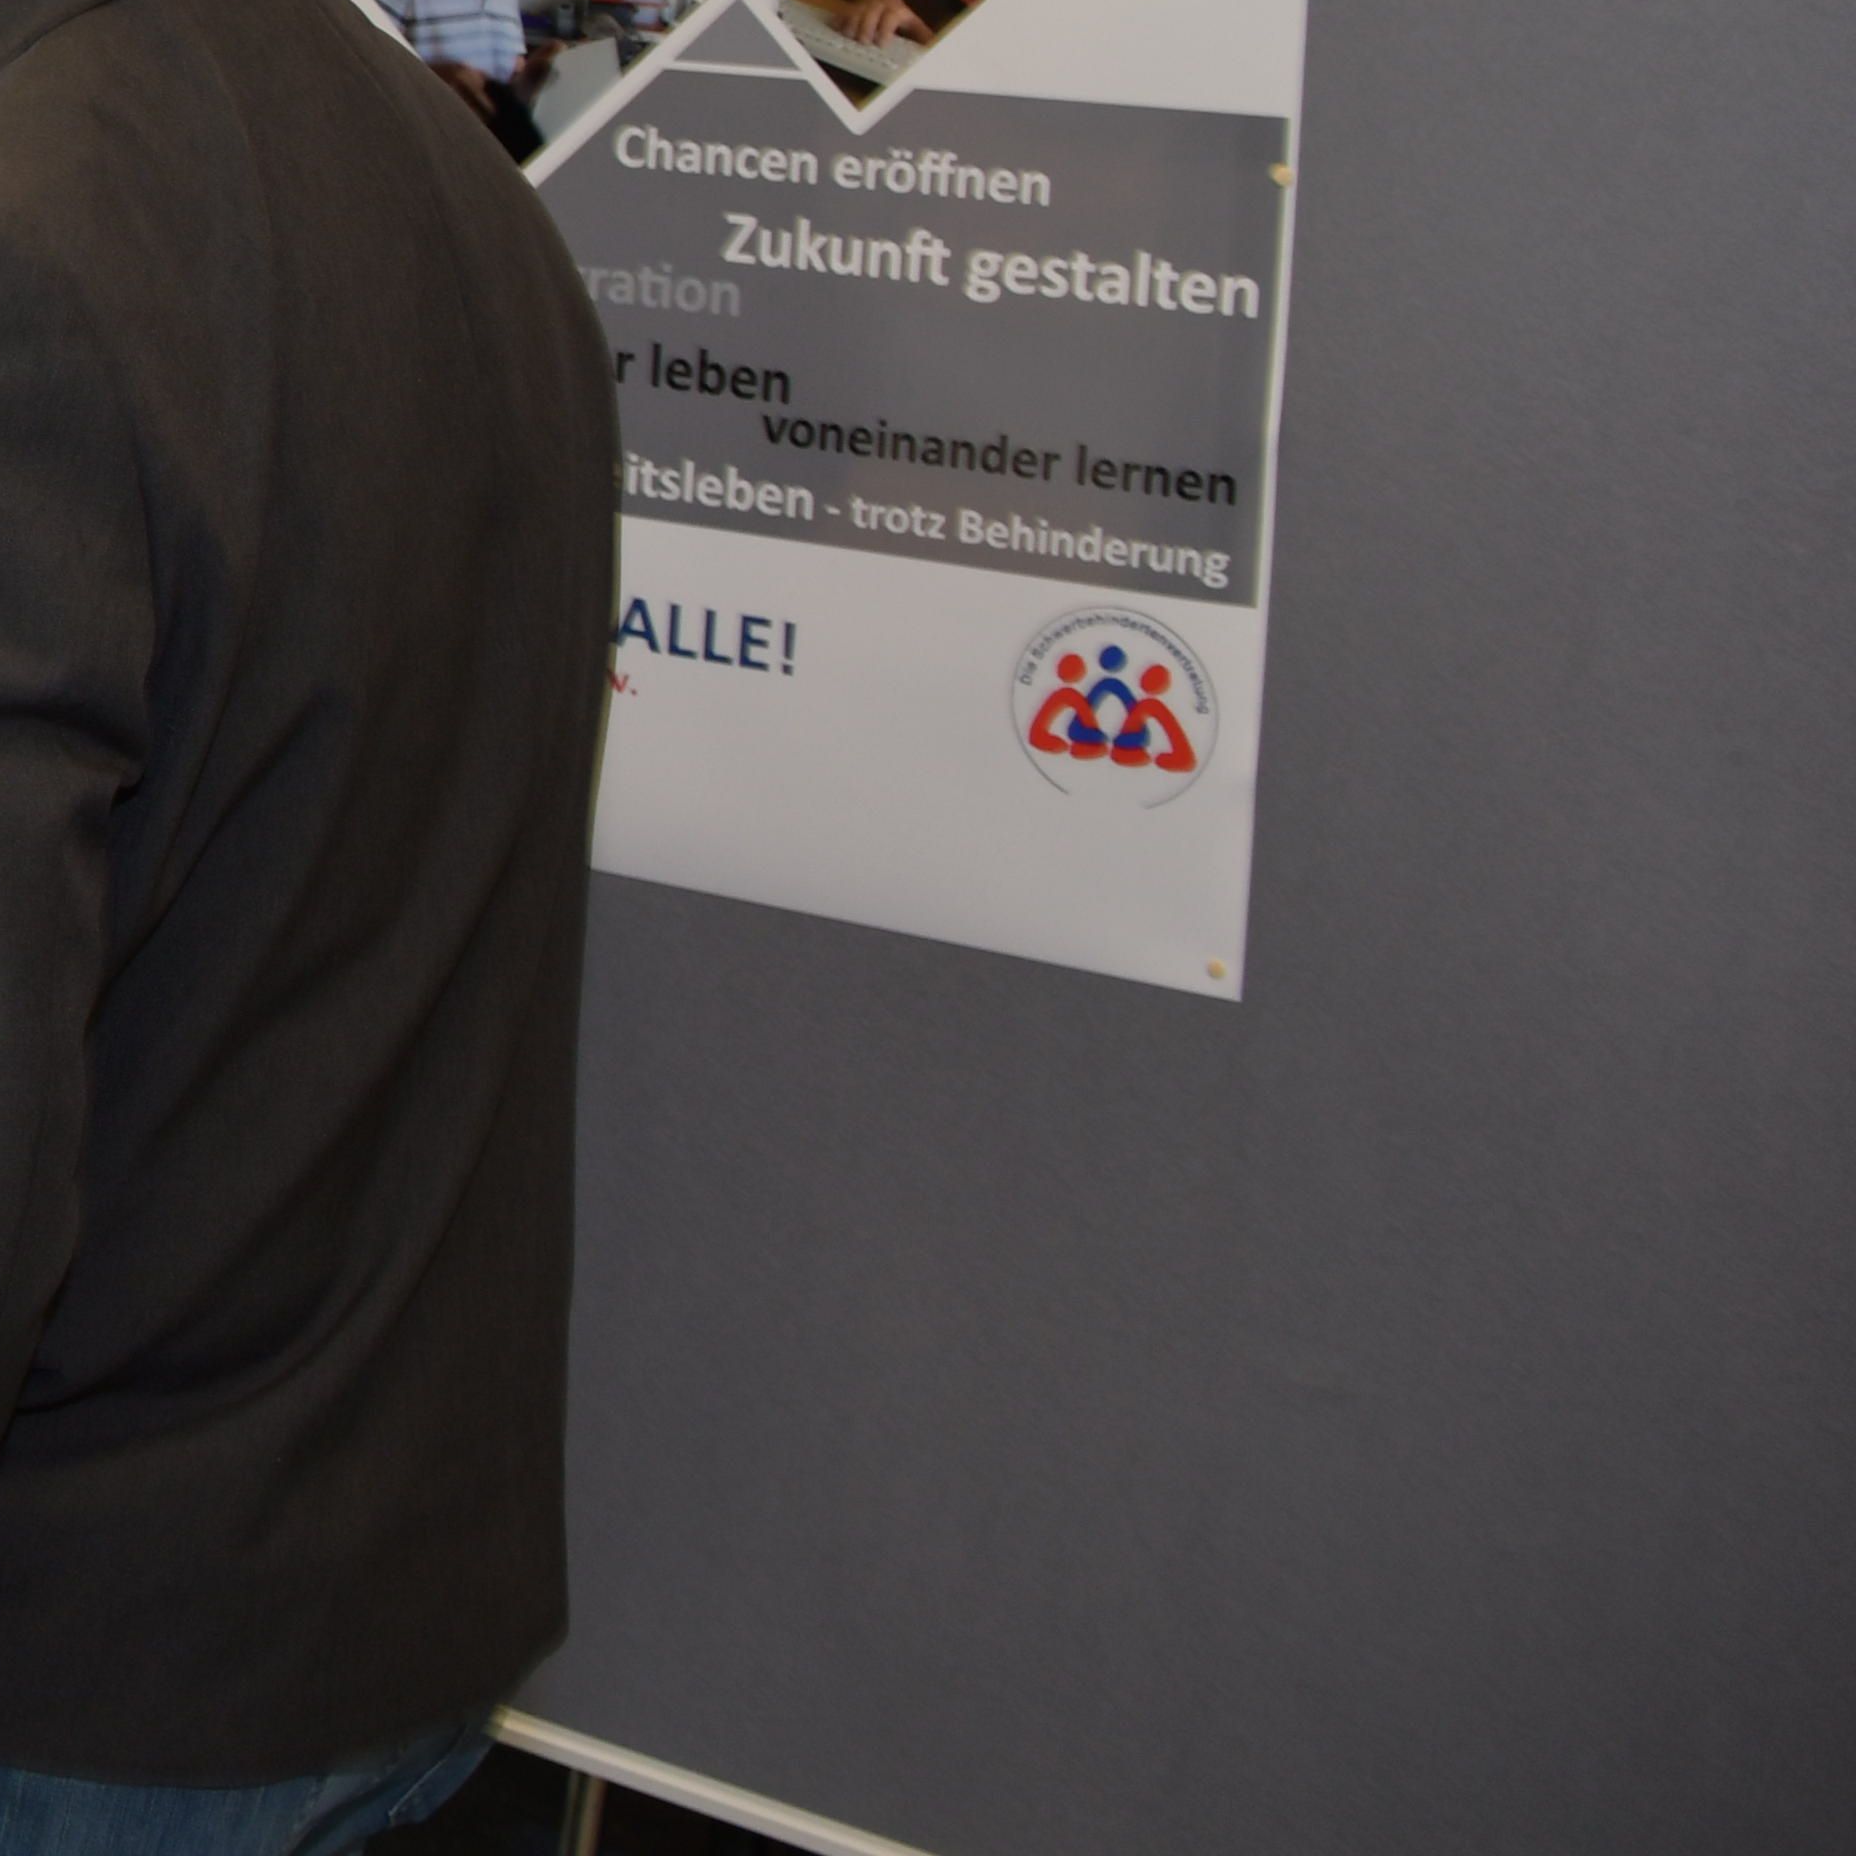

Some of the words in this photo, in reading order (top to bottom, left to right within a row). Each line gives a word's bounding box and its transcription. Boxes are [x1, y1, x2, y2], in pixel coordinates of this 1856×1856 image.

[614, 124, 817, 184] Chancen
[833, 147, 1051, 207] eröffnen
[722, 211, 951, 287] Zukunft
[963, 249, 1259, 319] gestalten
[651, 343, 792, 405] leben
[761, 413, 1061, 481] voneinander
[1076, 444, 1237, 507] lernen
[624, 450, 815, 522] itsleben
[849, 495, 947, 539] trotz
[957, 506, 1231, 590] Behinderung
[615, 596, 797, 677] ALLE!
